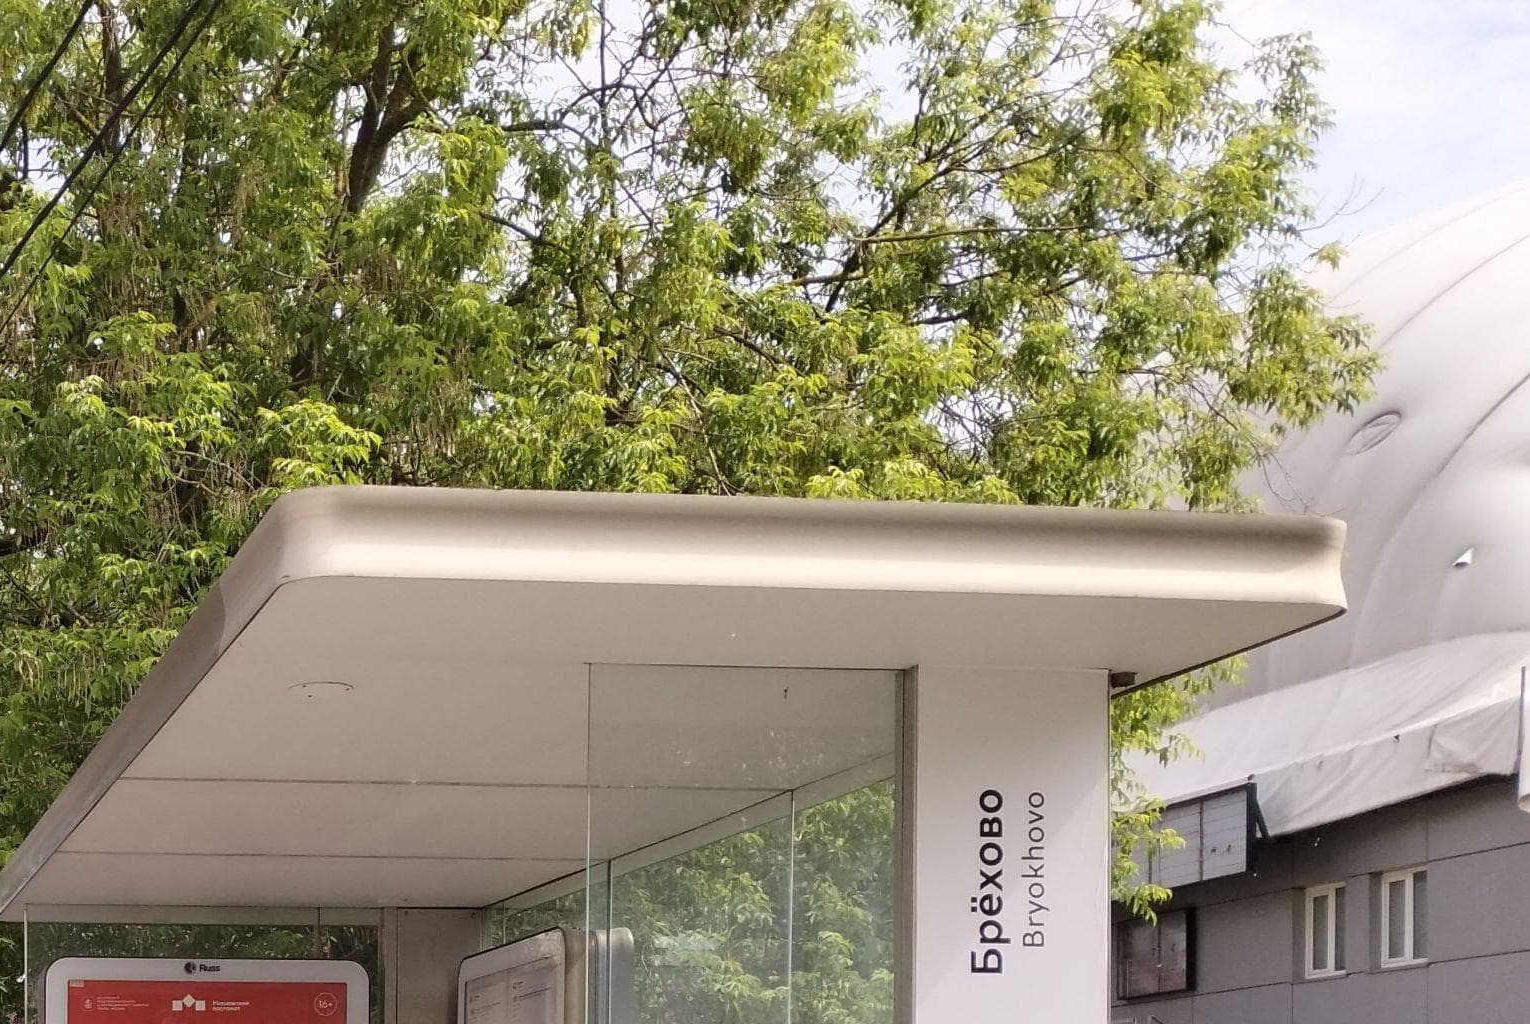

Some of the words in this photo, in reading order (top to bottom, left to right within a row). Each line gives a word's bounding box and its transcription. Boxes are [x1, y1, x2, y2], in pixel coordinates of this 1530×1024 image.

[971, 789, 1011, 974] Брёхово
[1021, 792, 1050, 947] Bryokhovo
[199, 964, 221, 973] Russ
[318, 1000, 333, 1009] 16+
